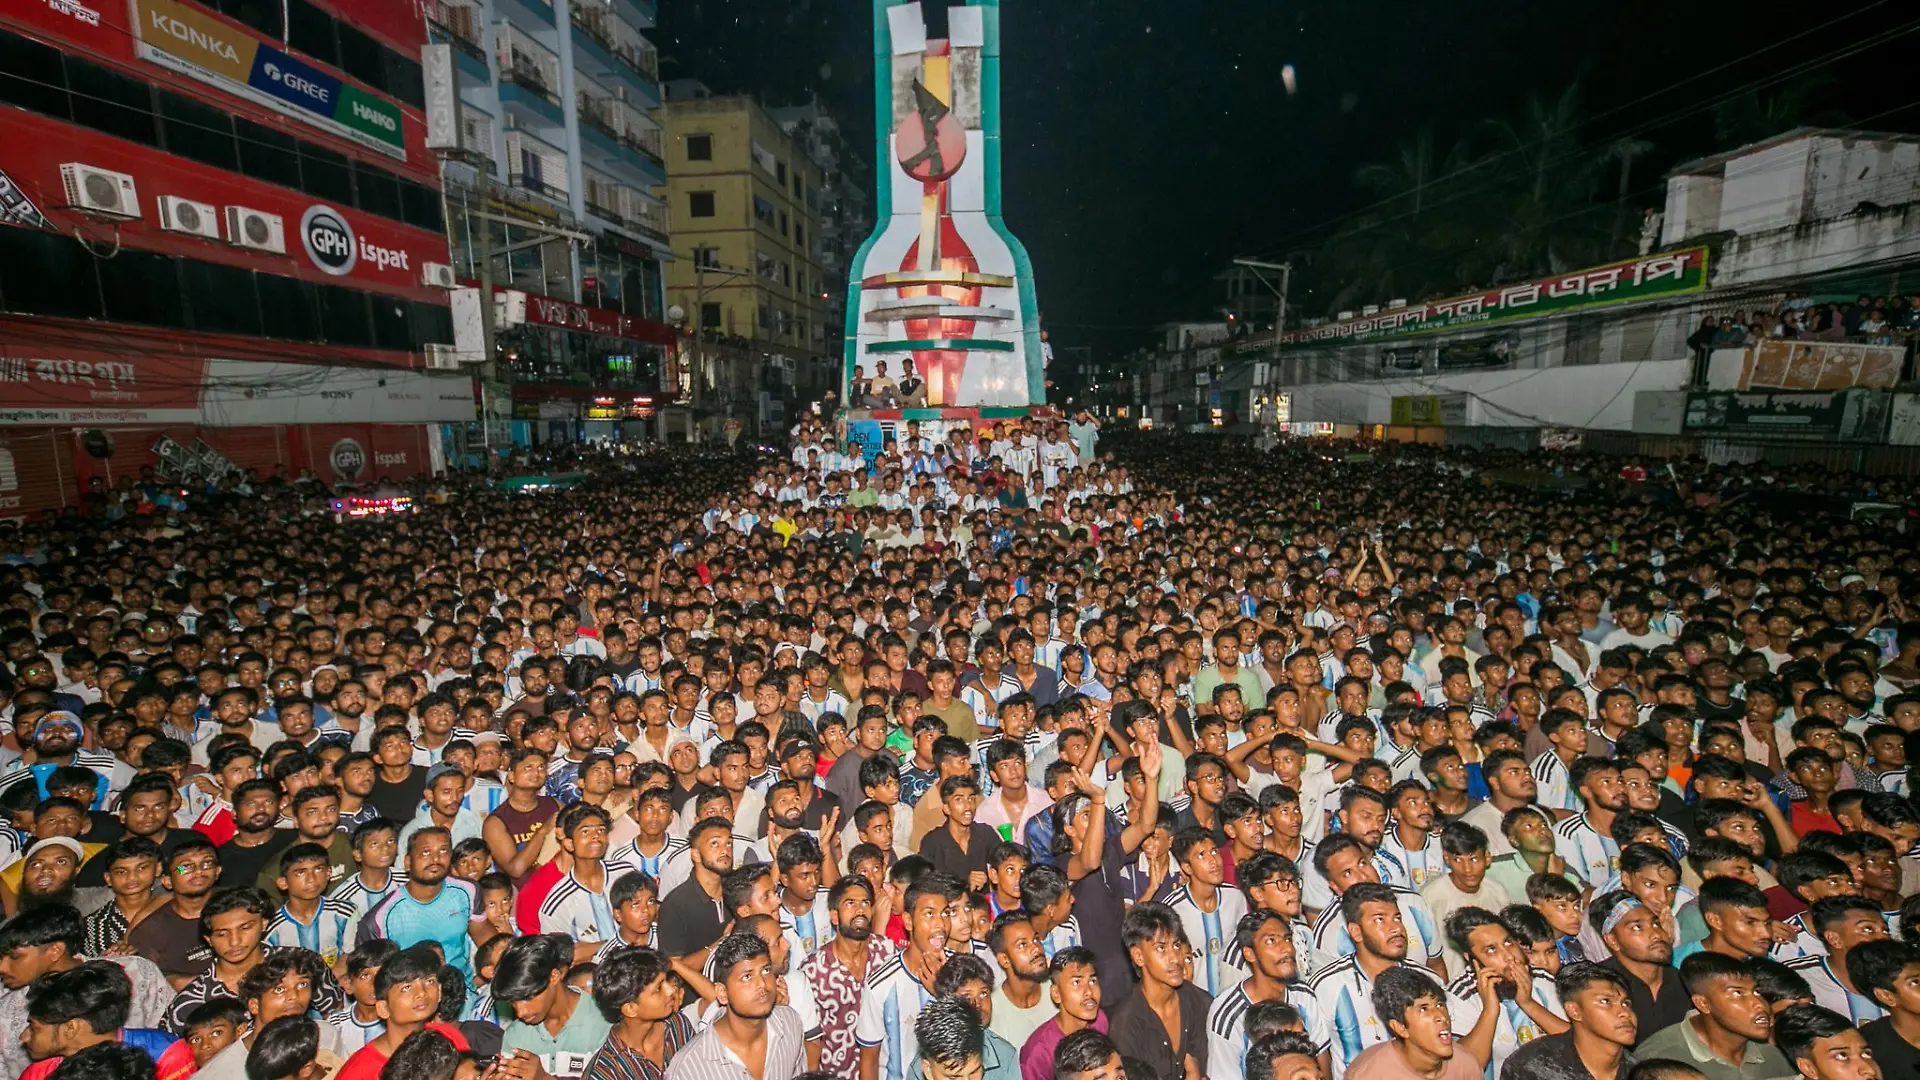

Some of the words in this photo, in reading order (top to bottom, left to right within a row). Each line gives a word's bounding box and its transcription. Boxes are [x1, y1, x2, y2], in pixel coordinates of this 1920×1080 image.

[151, 10, 240, 65] KONKA
[283, 72, 330, 104] GREE
[429, 47, 449, 145] KONKA
[352, 101, 397, 133] HAIKO
[311, 227, 348, 257] GPH
[359, 235, 409, 272] ispat
[534, 297, 590, 328] VISION
[321, 390, 355, 400] SONY
[854, 432, 870, 442] PEN
[336, 451, 361, 468] GPH
[374, 450, 407, 468] ispat
